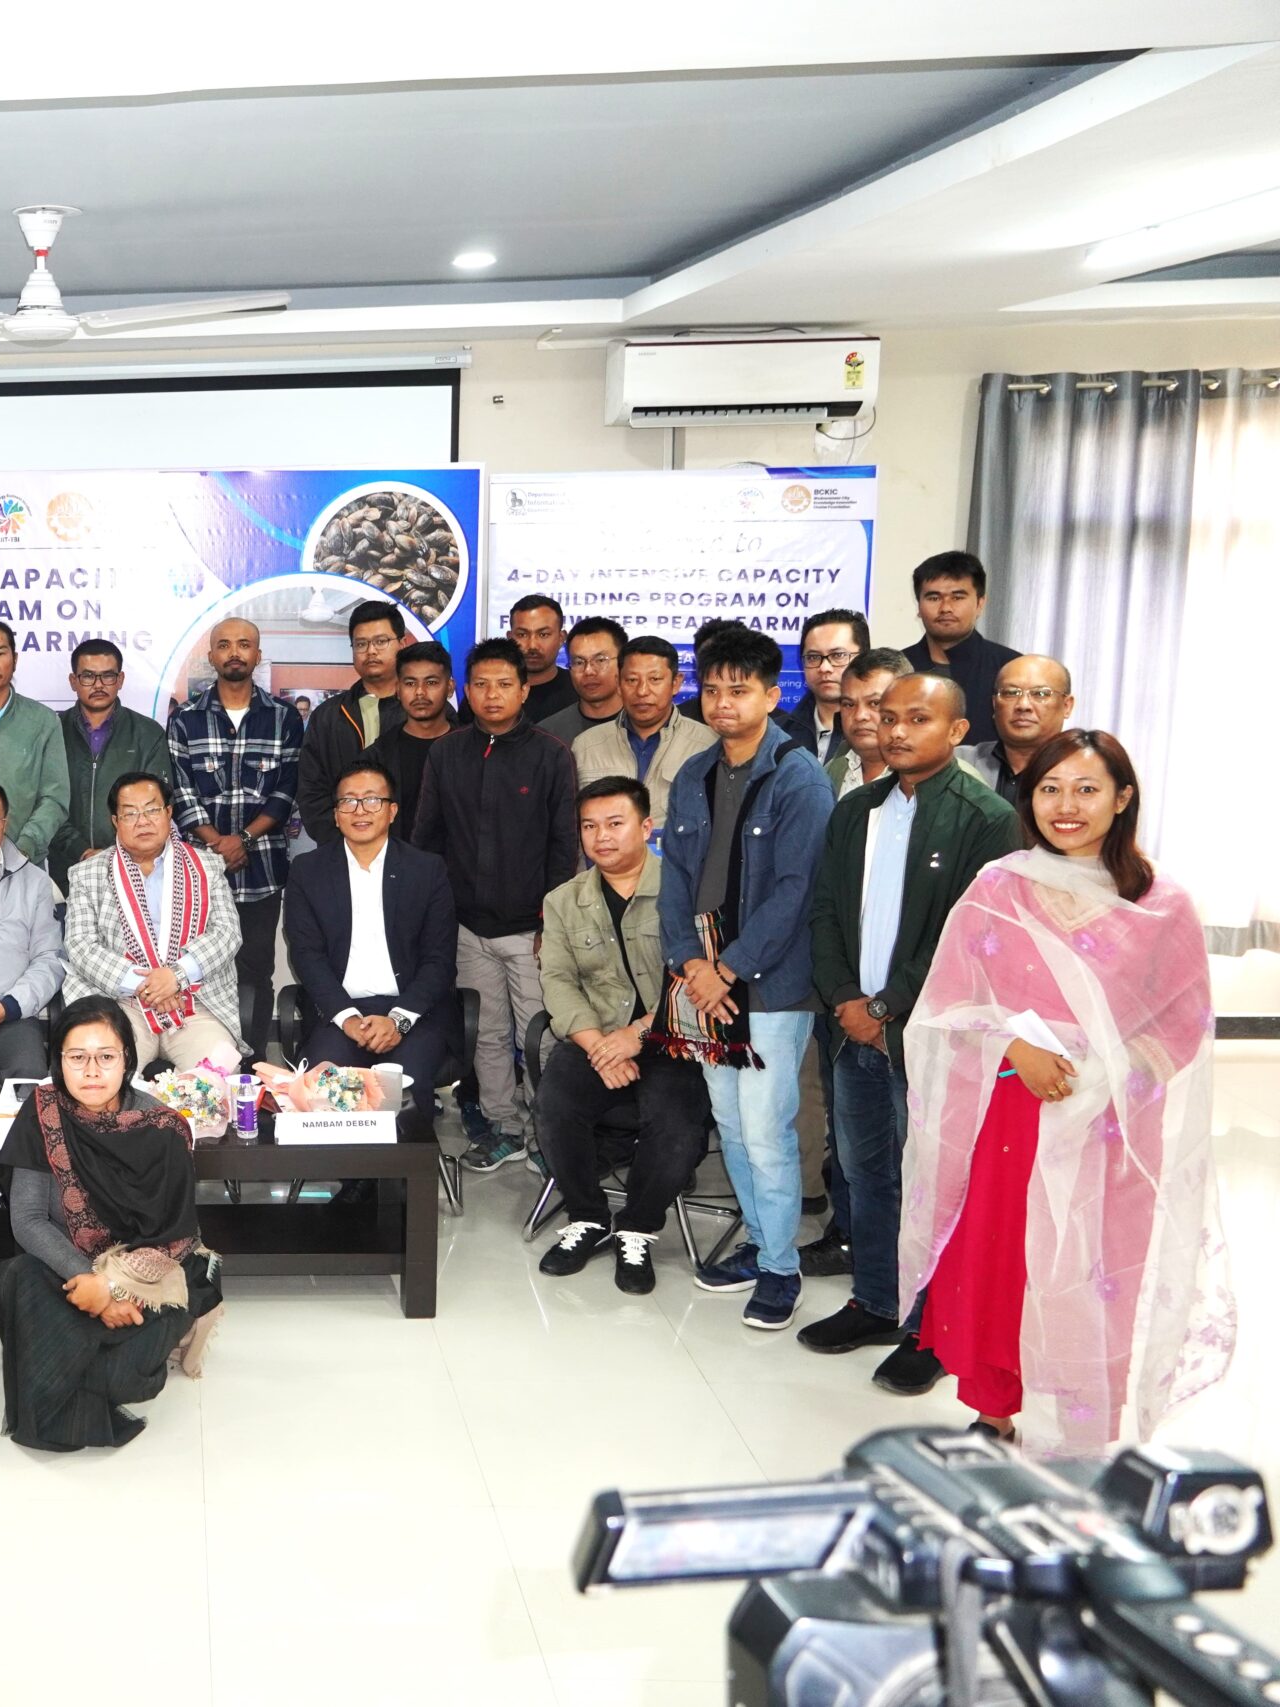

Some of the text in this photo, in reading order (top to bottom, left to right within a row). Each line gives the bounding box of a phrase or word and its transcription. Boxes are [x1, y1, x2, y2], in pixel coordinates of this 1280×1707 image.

[717, 568, 841, 584] CAPACITY
[649, 592, 766, 607] PROGRAM
[776, 592, 809, 608] ON
[56, 599, 102, 621] ON
[302, 1119, 377, 1128] NAMBAM DEBEN
